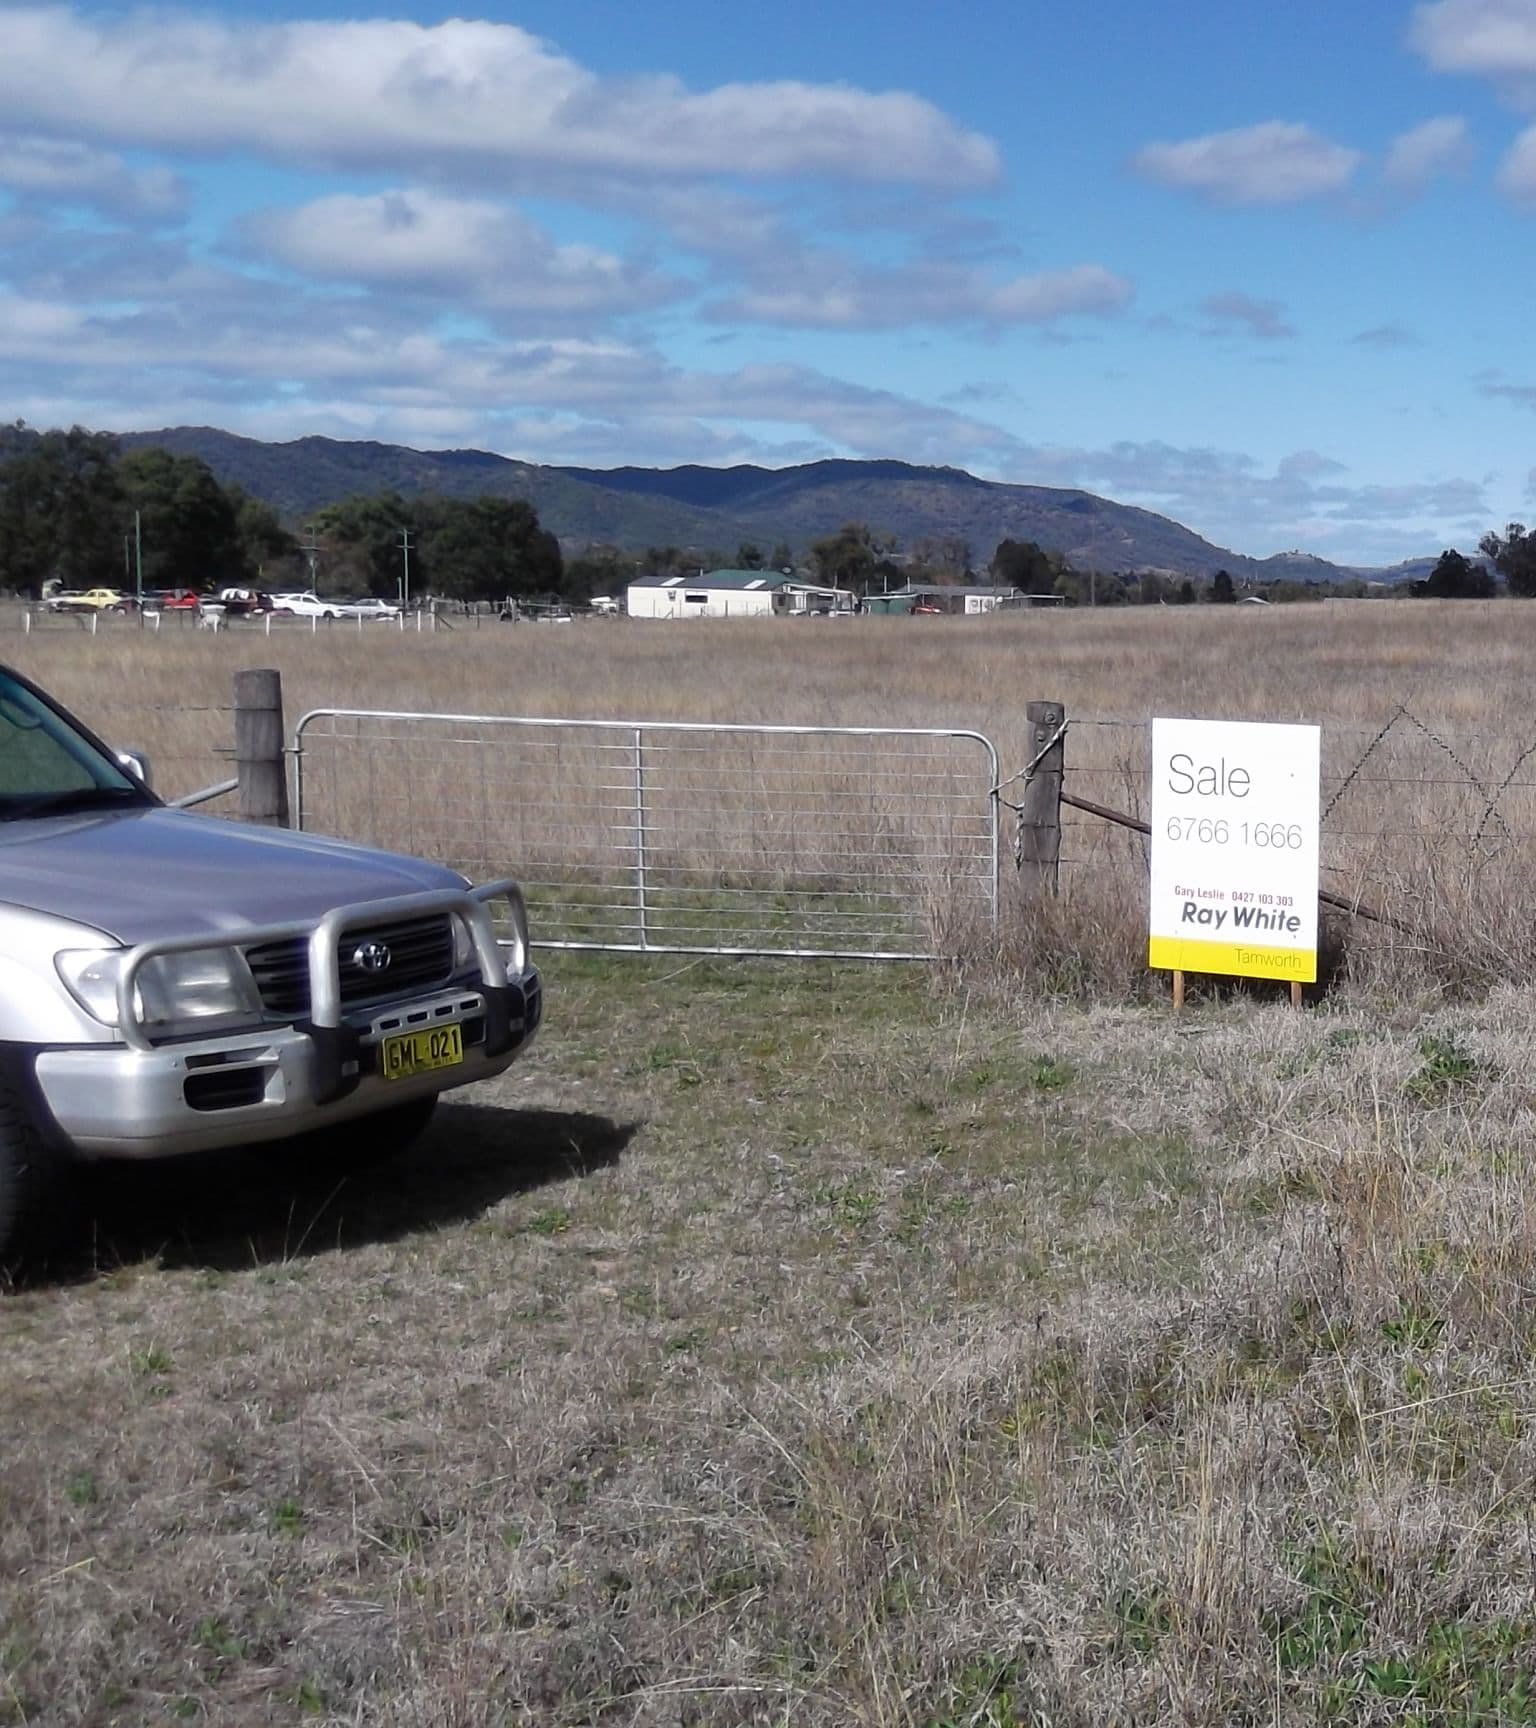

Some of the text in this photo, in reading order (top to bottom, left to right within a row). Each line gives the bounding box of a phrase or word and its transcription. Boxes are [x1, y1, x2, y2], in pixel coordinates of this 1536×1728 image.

[1168, 753, 1251, 798] Sale
[1167, 816, 1303, 850] 6766 1666
[1174, 885, 1294, 907] Gary Leslie 0427 103 303
[1181, 901, 1301, 932] Ray White
[1235, 948, 1302, 969] Tamworth
[431, 1028, 458, 1059] 021
